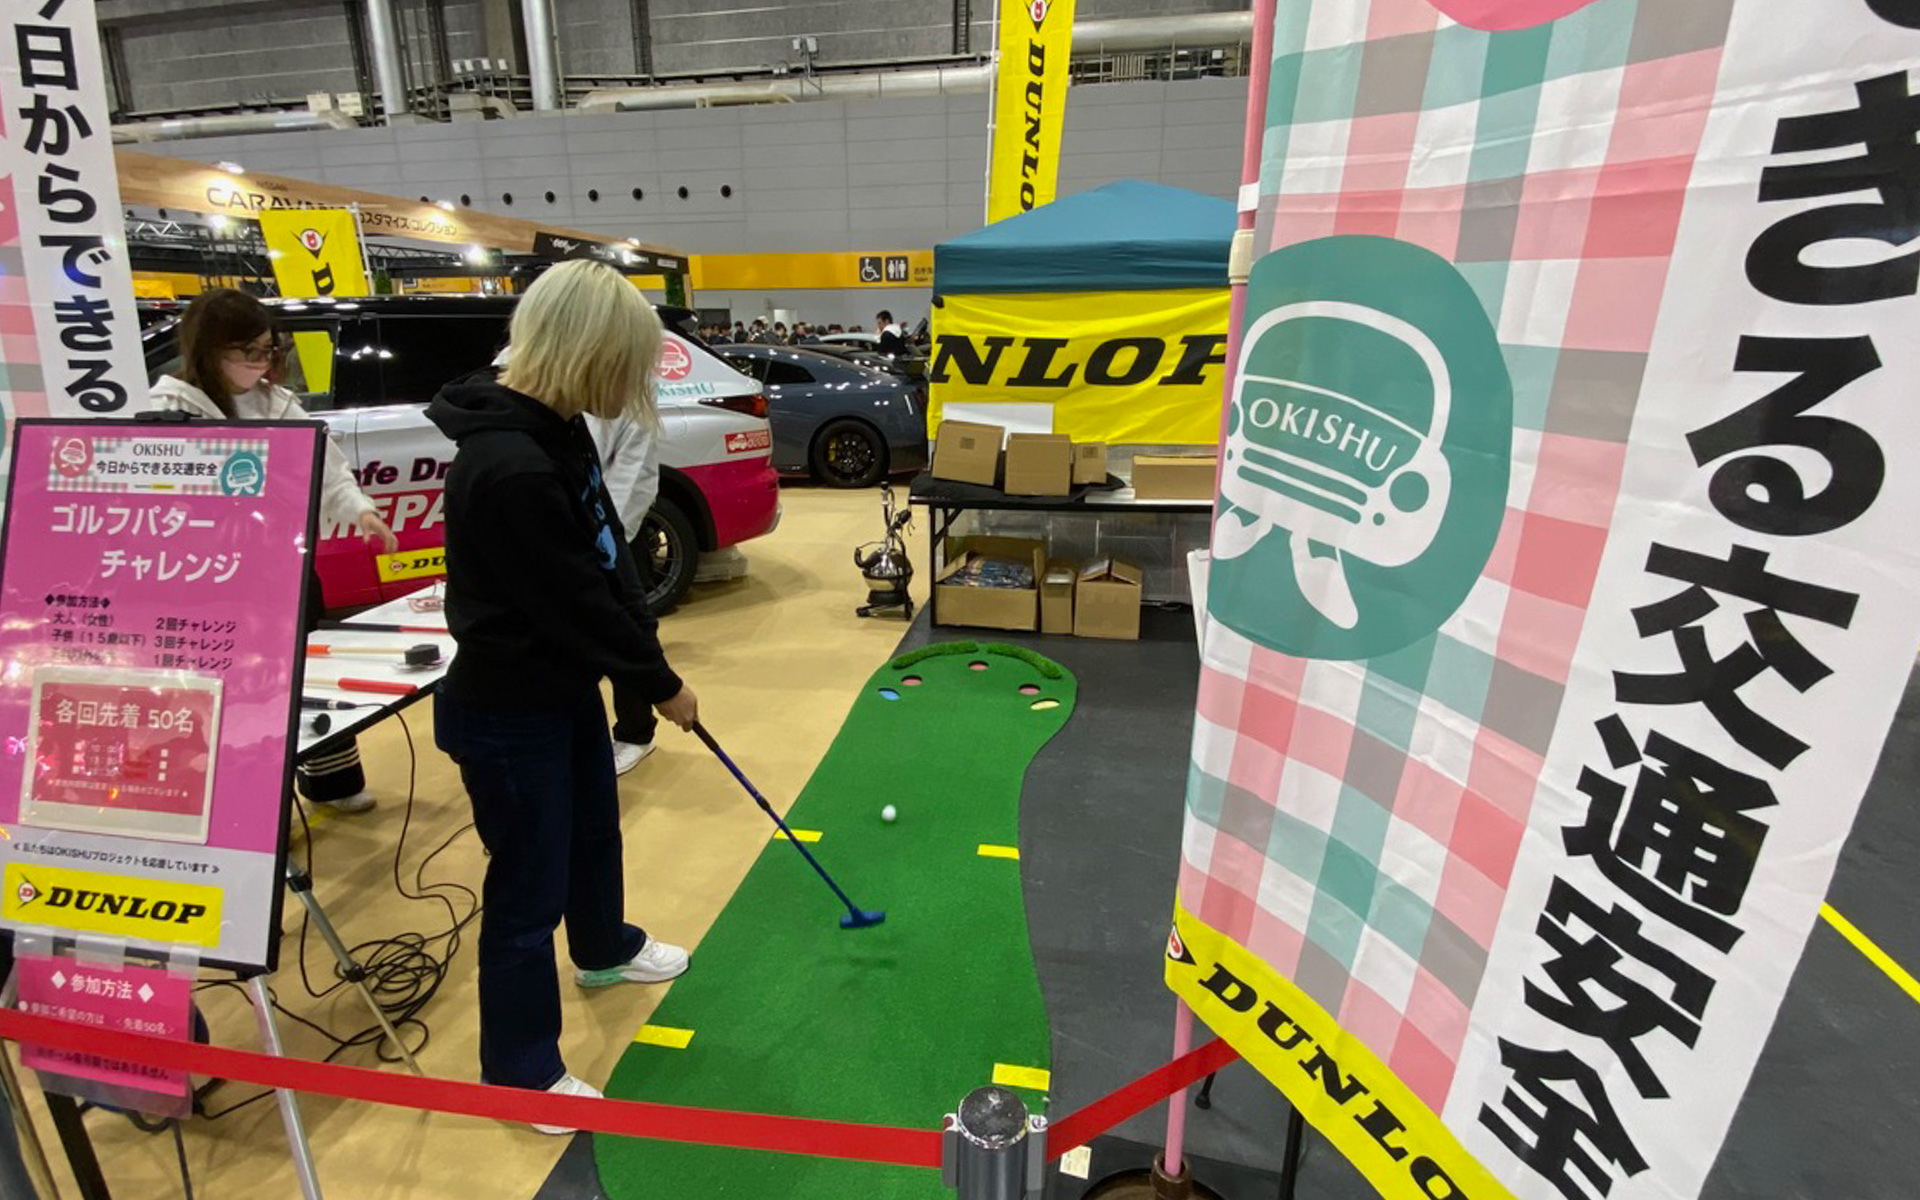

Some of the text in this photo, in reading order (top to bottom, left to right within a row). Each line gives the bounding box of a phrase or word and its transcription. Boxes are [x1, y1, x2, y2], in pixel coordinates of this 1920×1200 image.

[14, 0, 128, 413] 日からできる
[132, 443, 184, 457] OKISHU
[1249, 397, 1398, 472] OKISHU
[96, 460, 218, 477] 今日からできる交通安全
[51, 503, 215, 538] ゴルフパター
[101, 549, 242, 583] チャレンジ
[1477, 0, 1920, 1200] きる交通安全
[155, 616, 238, 634] 2回チャレンジ
[153, 635, 236, 653] 3回チャレンジ
[55, 699, 194, 734] 各回先着 50名
[45, 885, 206, 924] DUNLOP
[70, 973, 133, 1000] 参加方法
